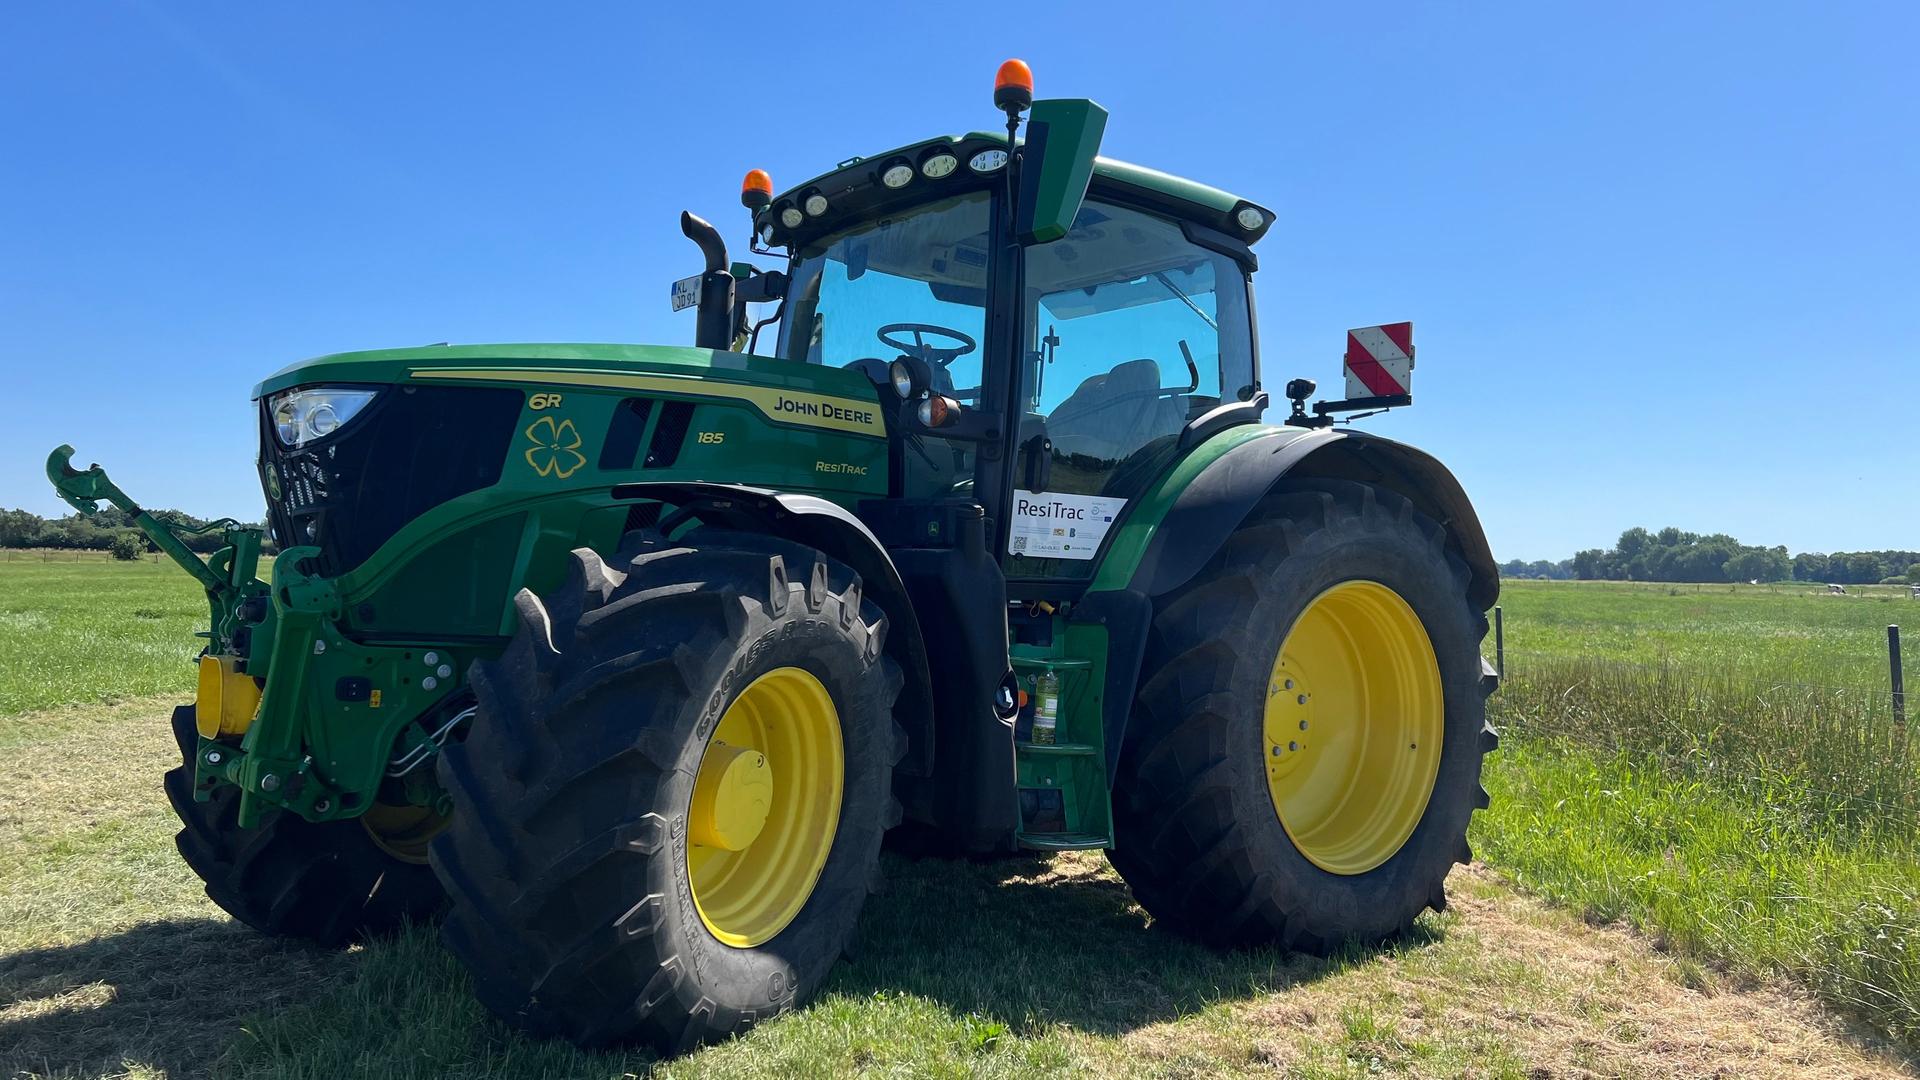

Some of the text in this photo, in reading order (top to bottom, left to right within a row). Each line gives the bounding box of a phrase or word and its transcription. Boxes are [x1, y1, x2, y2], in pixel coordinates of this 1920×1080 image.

[528, 393, 563, 410] 6R
[774, 396, 873, 425] JOHN DEERE
[697, 431, 725, 445] 185
[1017, 499, 1085, 520] ResiTrac
